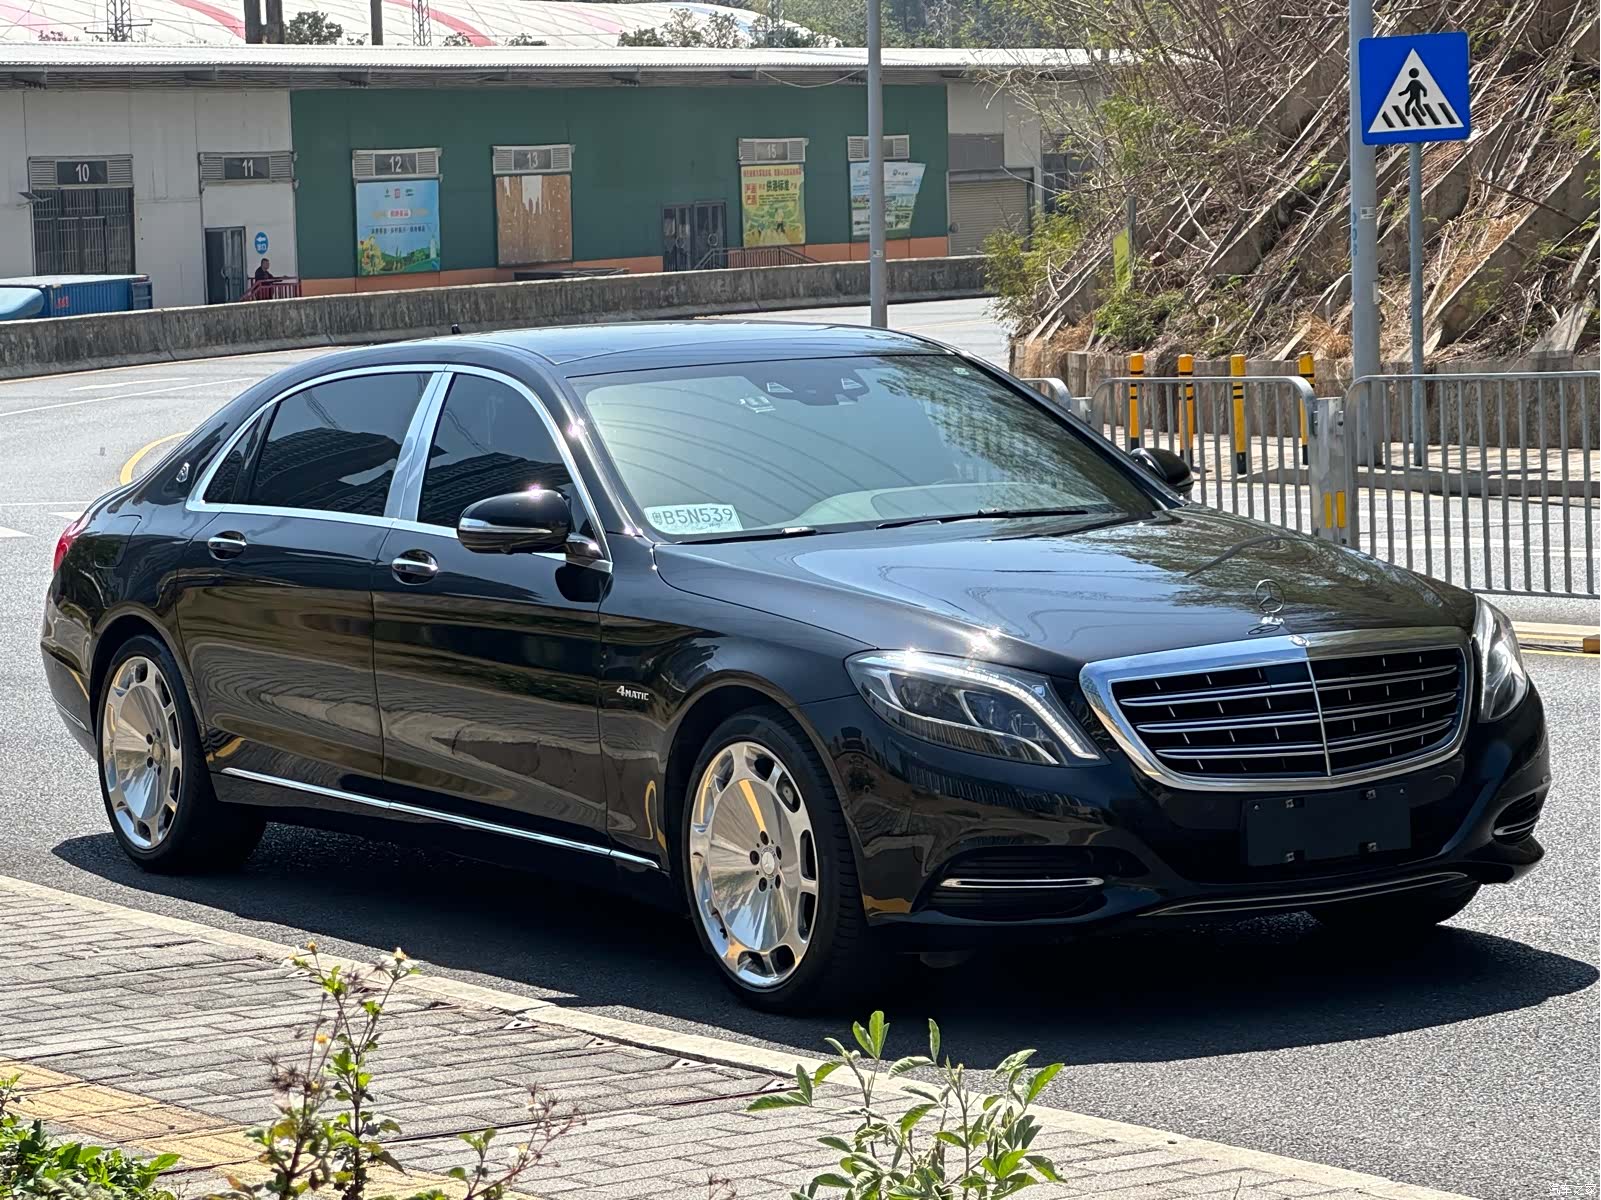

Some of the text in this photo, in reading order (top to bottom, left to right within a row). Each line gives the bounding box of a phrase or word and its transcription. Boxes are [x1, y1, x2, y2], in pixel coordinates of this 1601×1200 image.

[767, 144, 777, 159] 15
[242, 159, 254, 177] 11
[389, 156, 402, 173] 12
[526, 152, 538, 168] 13
[75, 163, 90, 182] 10
[616, 685, 650, 701] 4MATIC
